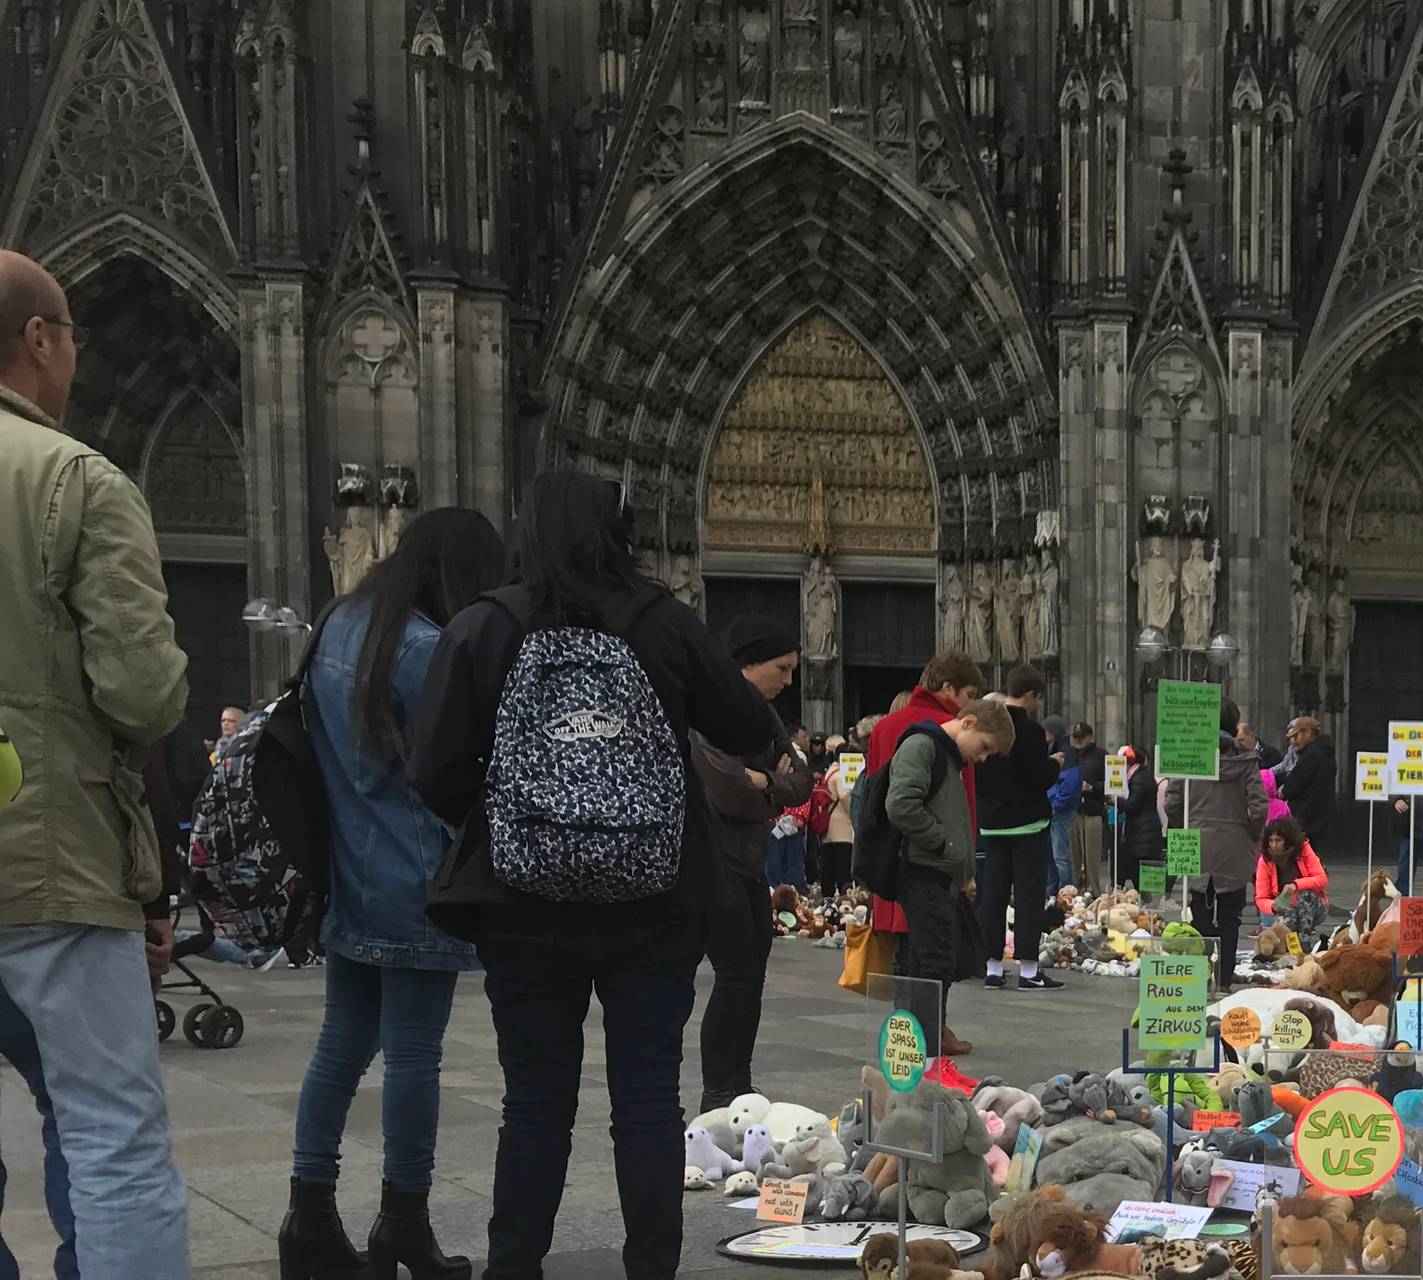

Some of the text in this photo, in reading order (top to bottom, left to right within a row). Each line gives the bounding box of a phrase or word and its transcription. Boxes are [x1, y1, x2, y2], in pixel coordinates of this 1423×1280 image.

[573, 722, 592, 733] THE
[1406, 750, 1422, 758] DER
[1147, 984, 1183, 998] RAUS
[1166, 1005, 1204, 1013] AUS DEM
[890, 1018, 911, 1033] EUER
[1282, 1014, 1303, 1026] Stop
[1275, 1024, 1304, 1038] killing
[891, 1032, 916, 1048] SPASS
[885, 1048, 925, 1064] IST UNSER
[892, 1062, 910, 1077] LEID
[1305, 1110, 1394, 1142] SAVE
[1323, 1147, 1377, 1176] US
